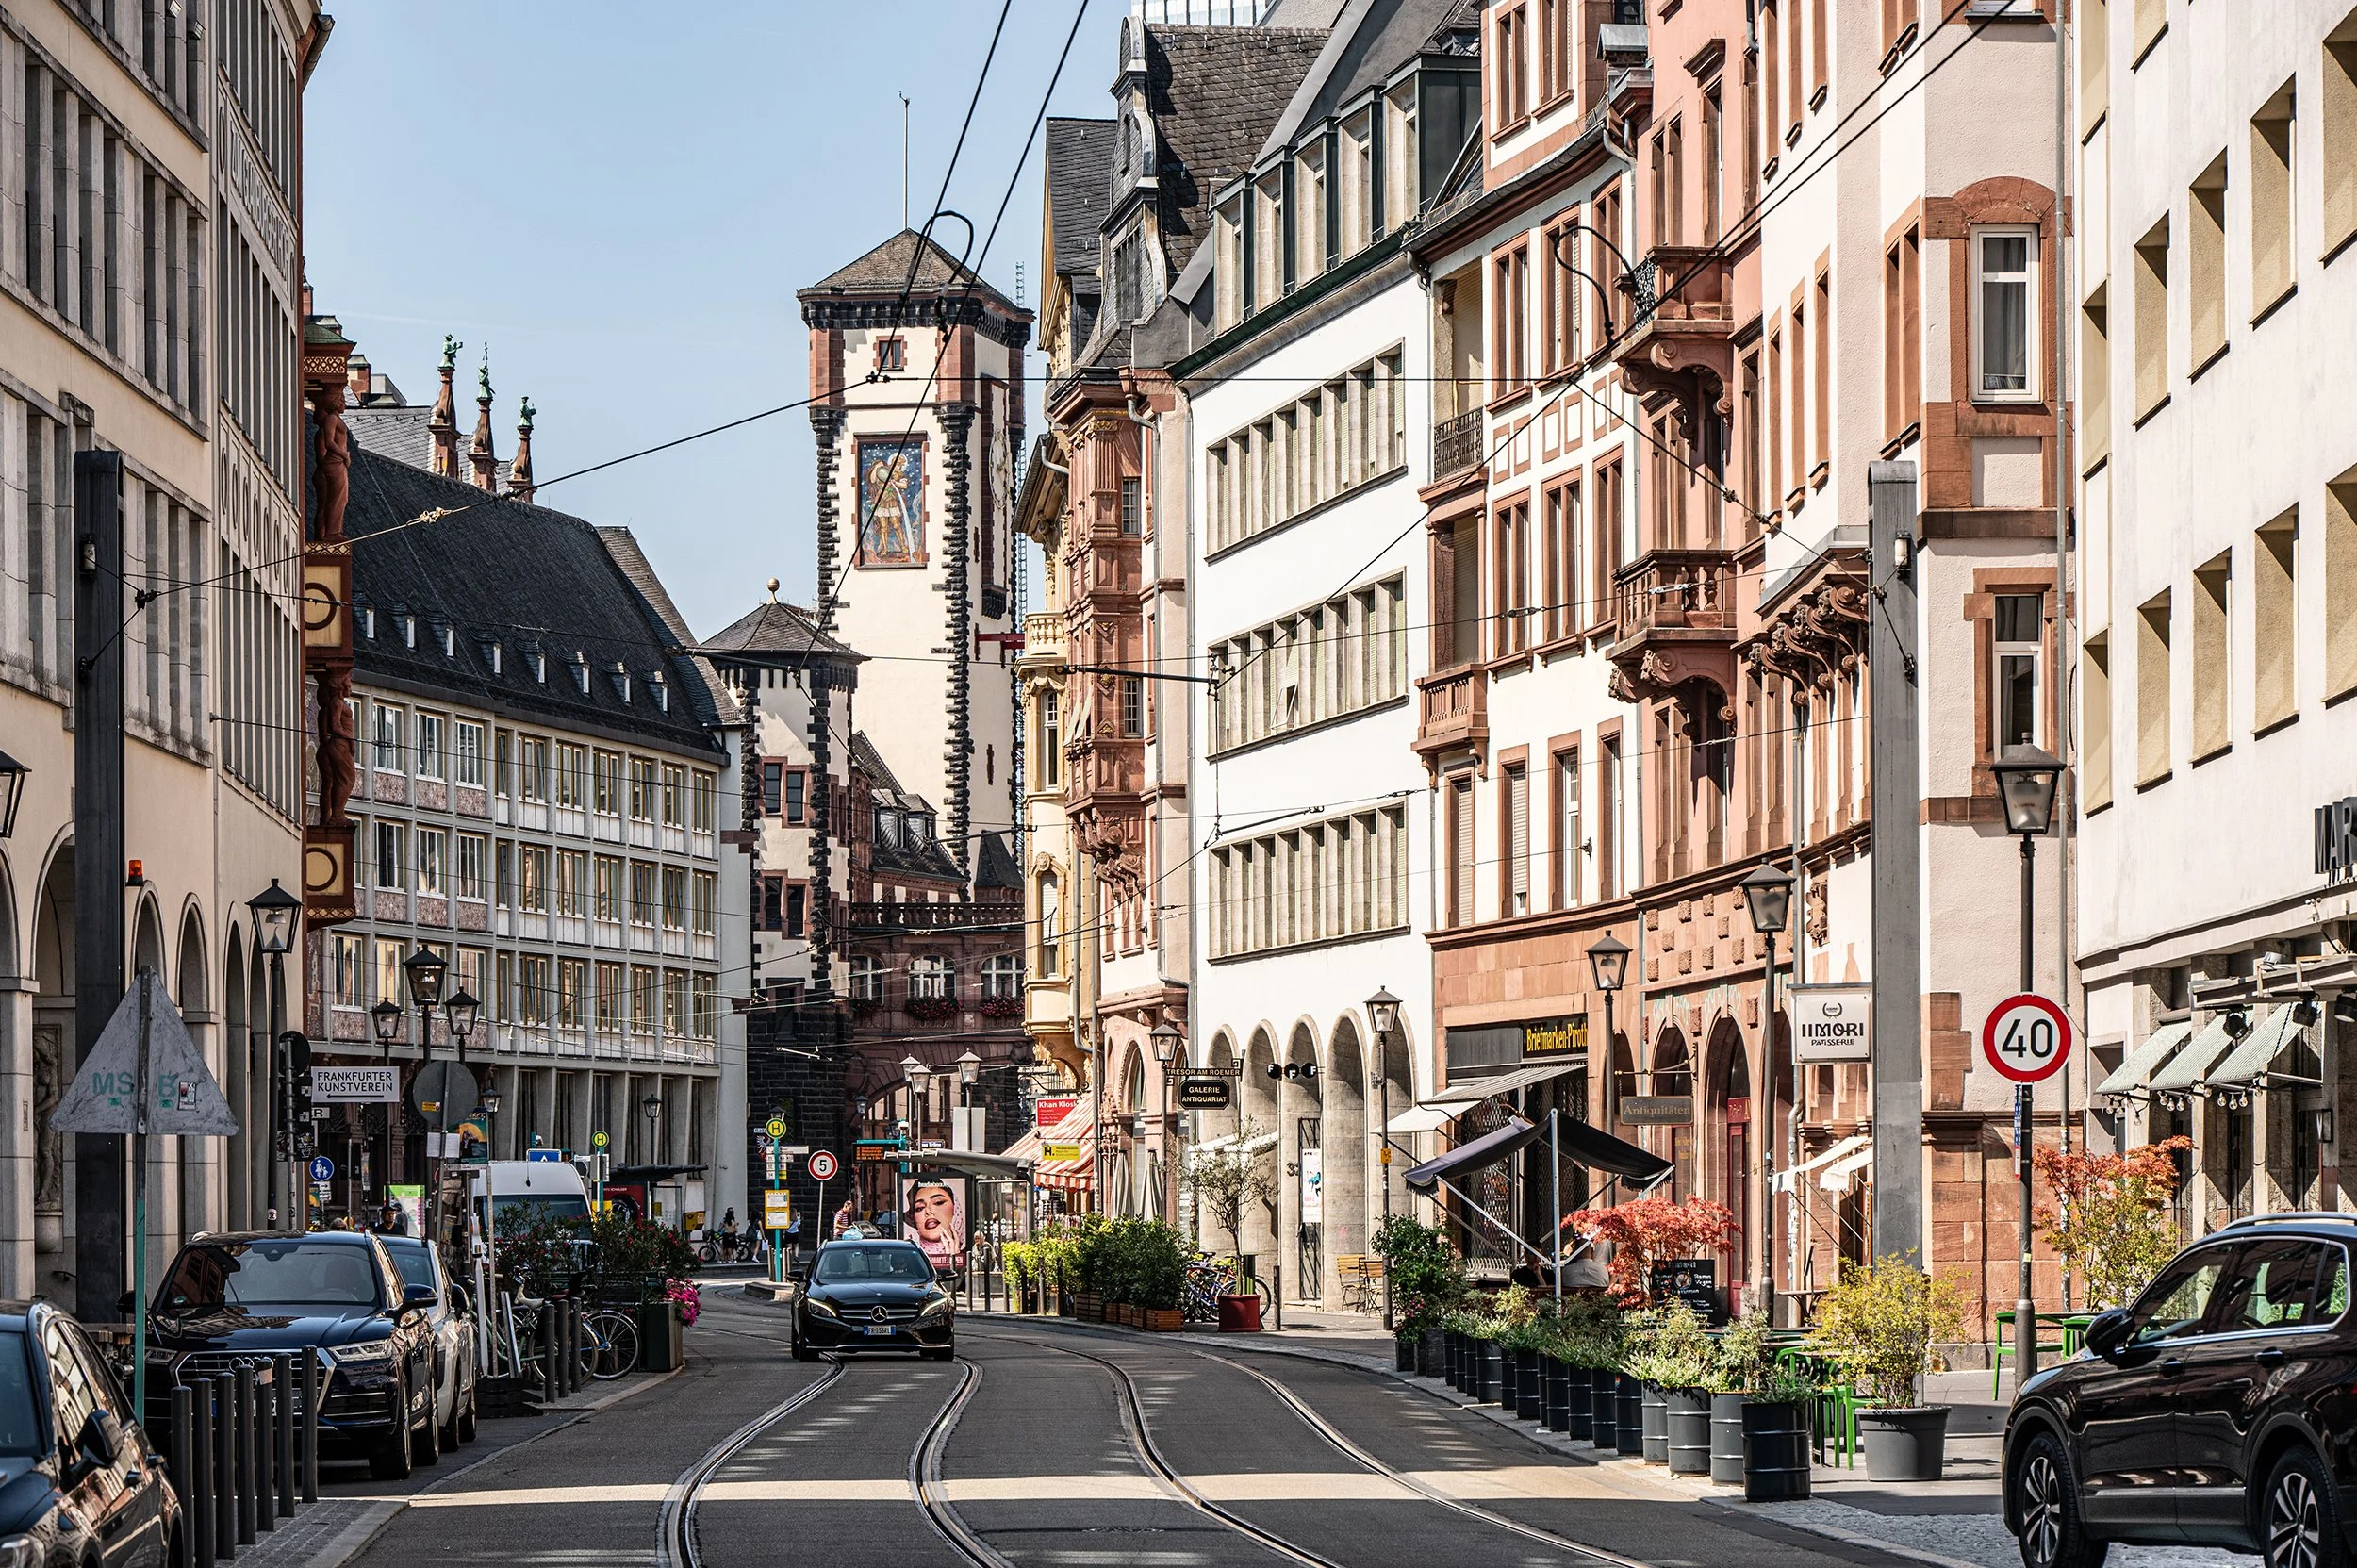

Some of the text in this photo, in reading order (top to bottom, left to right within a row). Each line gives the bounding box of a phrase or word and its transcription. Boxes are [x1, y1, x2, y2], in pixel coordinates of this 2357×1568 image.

[1802, 1022, 1864, 1037] IIMORI
[2002, 1018, 2053, 1058] 40
[317, 1071, 392, 1081] FRANKFURTER
[1267, 1065, 1317, 1080] F F F
[317, 1082, 393, 1092] KUNSTVEREIN
[1623, 1104, 1690, 1118] Antiquitäten
[771, 1123, 781, 1134] H
[597, 1134, 604, 1145] H
[818, 1159, 827, 1172] 5
